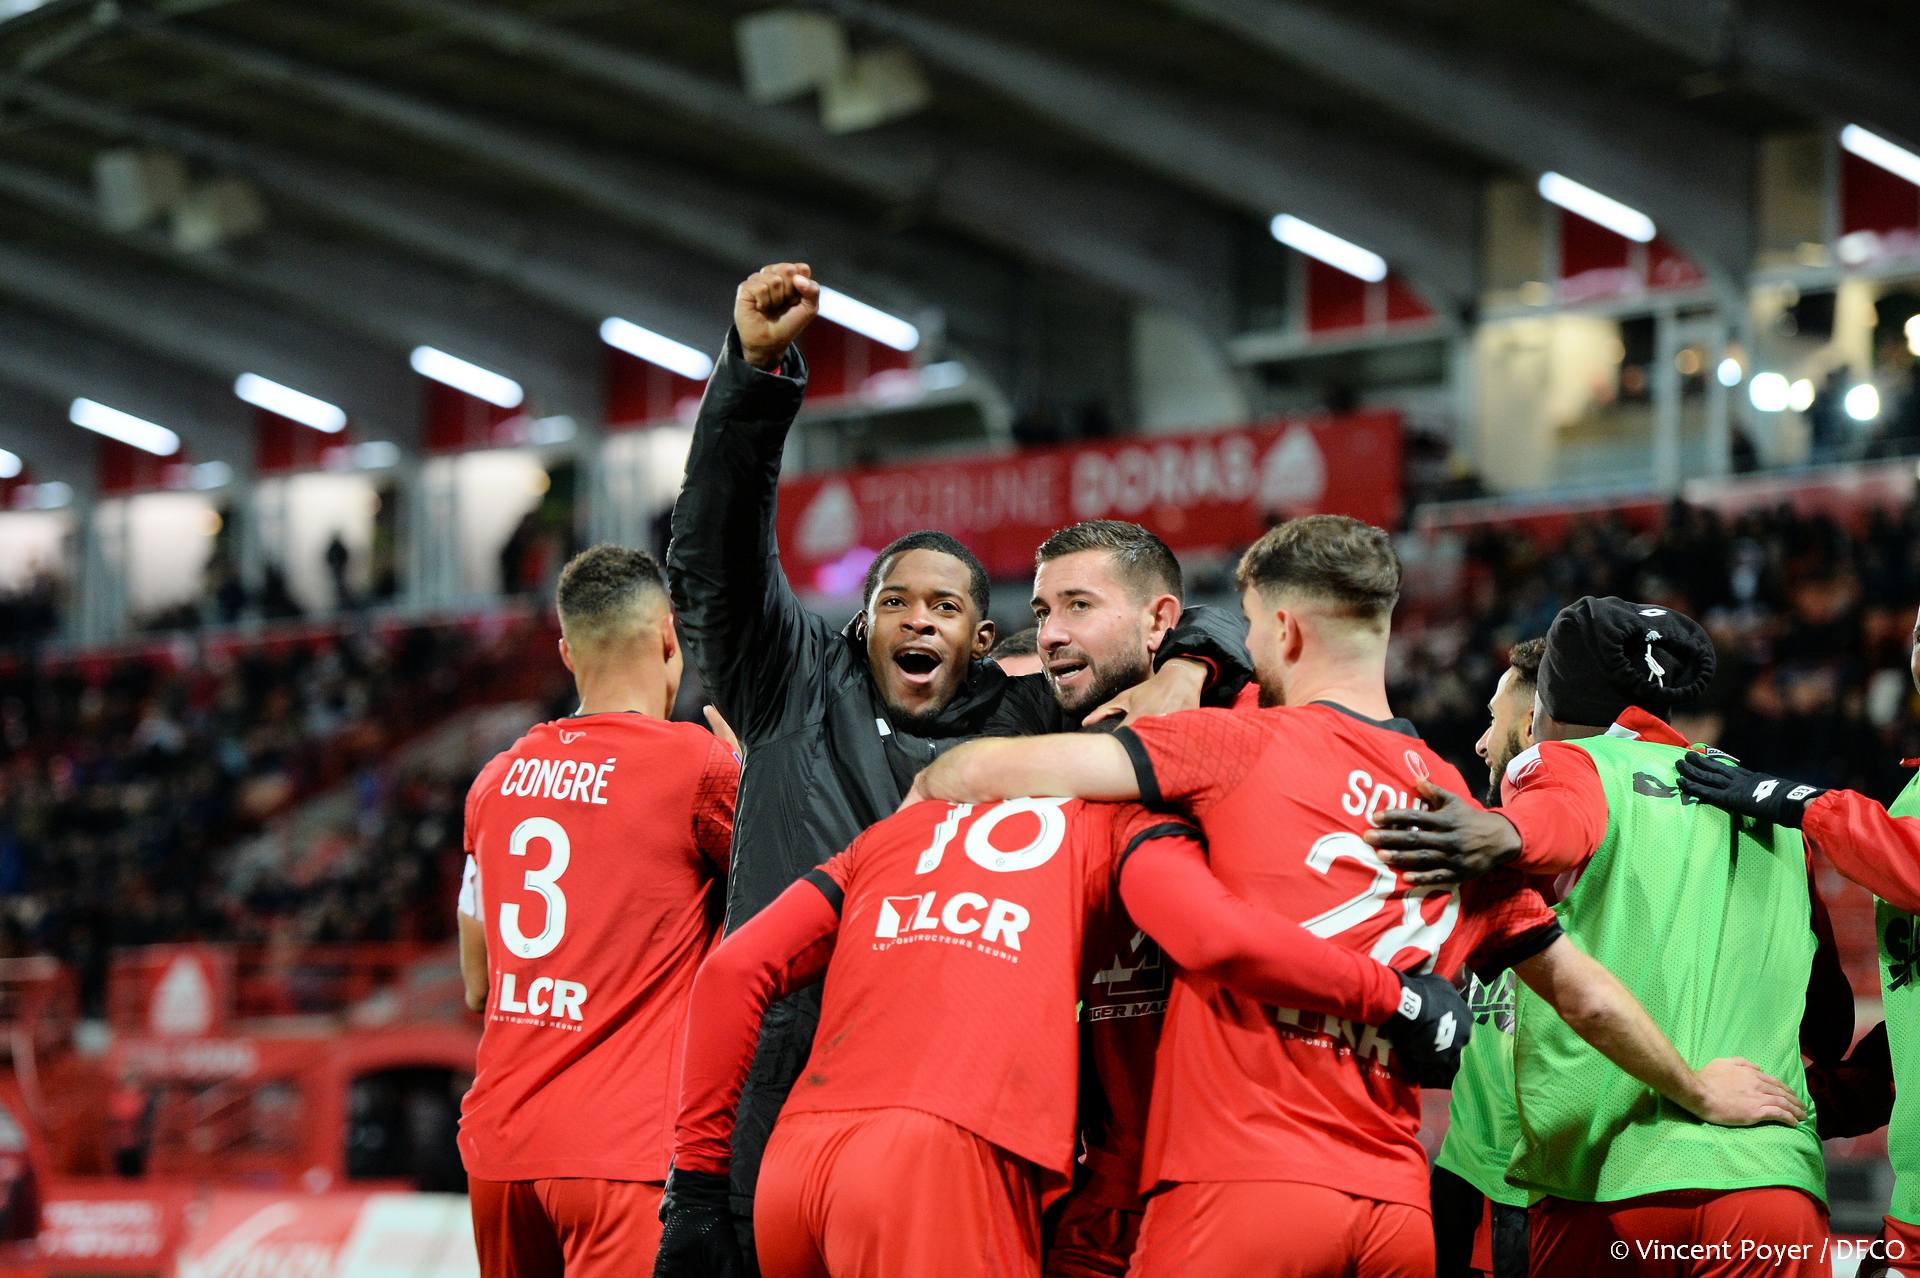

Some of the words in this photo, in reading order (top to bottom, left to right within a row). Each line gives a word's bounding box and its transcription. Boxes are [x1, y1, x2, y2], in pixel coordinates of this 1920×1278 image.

[1072, 438, 1256, 517] DORAS
[501, 758, 617, 805] CONGRÉ
[499, 817, 571, 959] 3
[911, 891, 1031, 951] LCR
[1299, 832, 1461, 975] 28
[499, 973, 588, 1021] LCR
